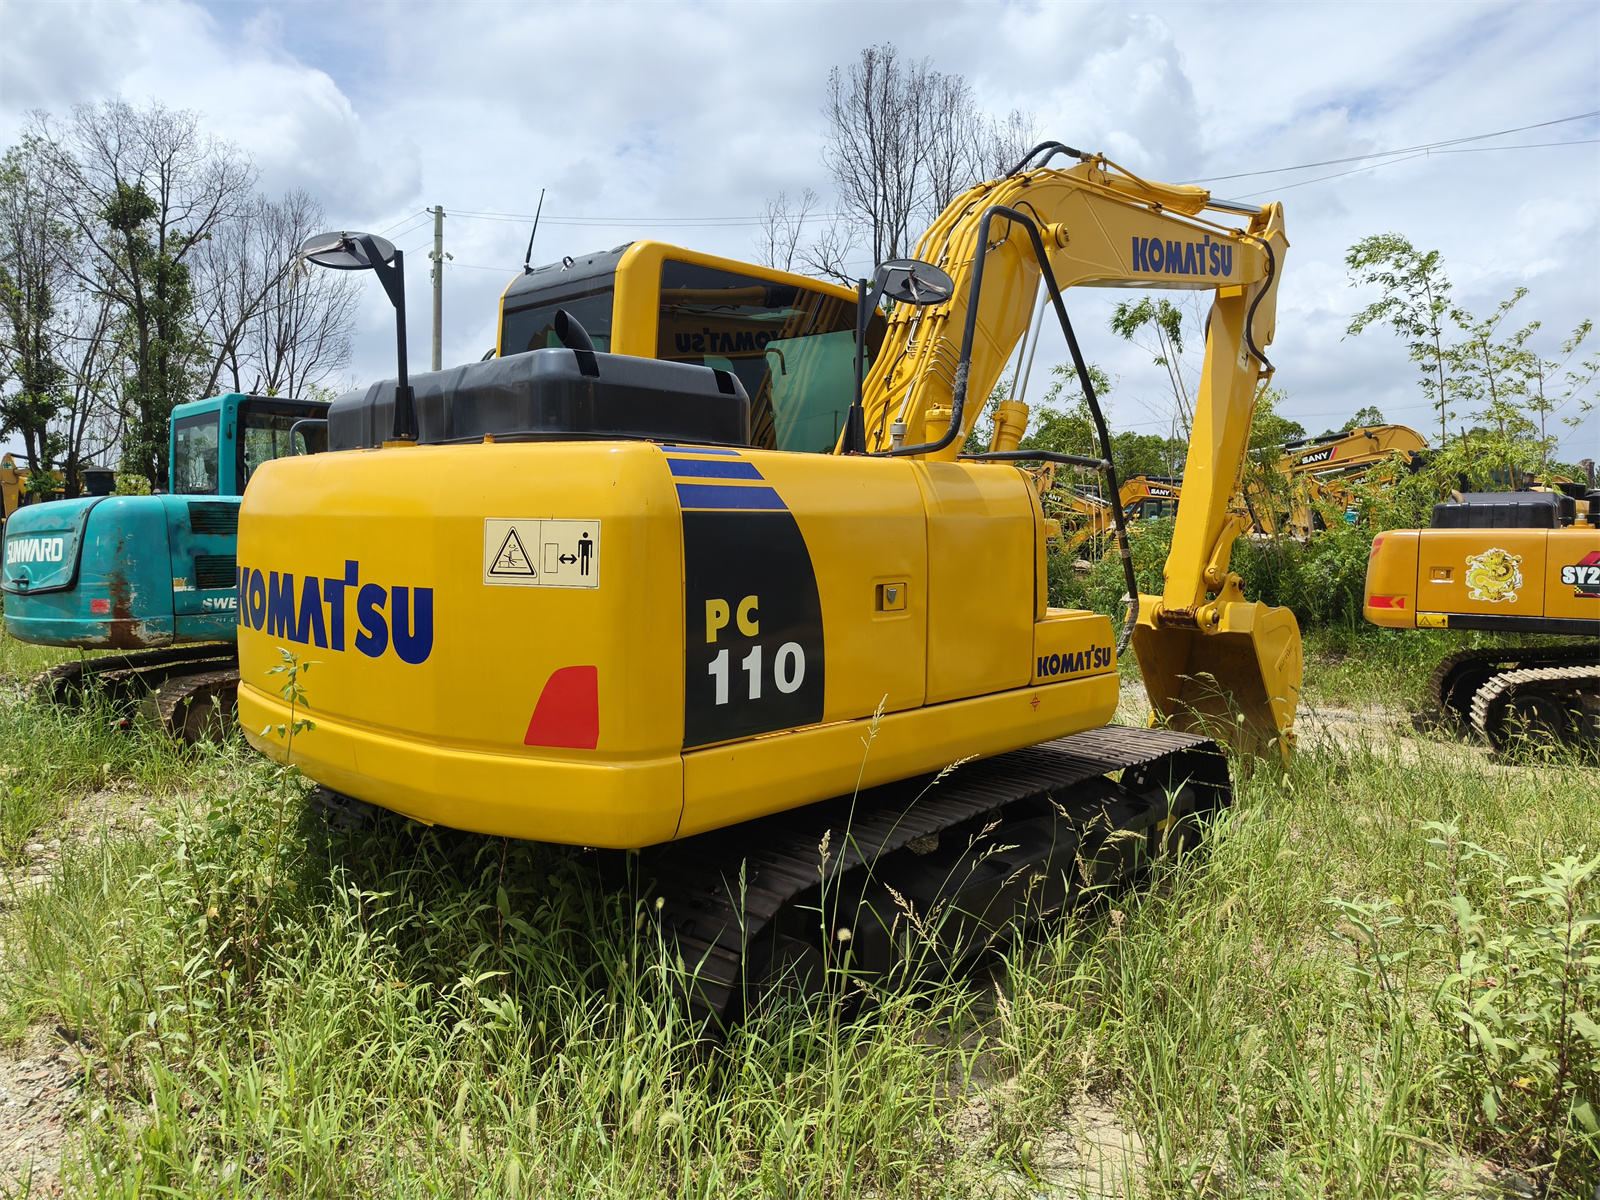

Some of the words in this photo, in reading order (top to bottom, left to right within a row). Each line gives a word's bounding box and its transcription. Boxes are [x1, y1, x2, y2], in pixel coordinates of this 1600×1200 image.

[1132, 235, 1232, 276] KOMATSU
[1302, 451, 1329, 464] SANY
[1150, 488, 1170, 496] SANY
[7, 538, 63, 564] SUNWARD
[1562, 566, 1600, 584] SY2
[236, 560, 433, 664] KOMATSU
[706, 595, 760, 643] PC
[708, 642, 805, 705] 110
[1037, 644, 1111, 677] KOMATSU
